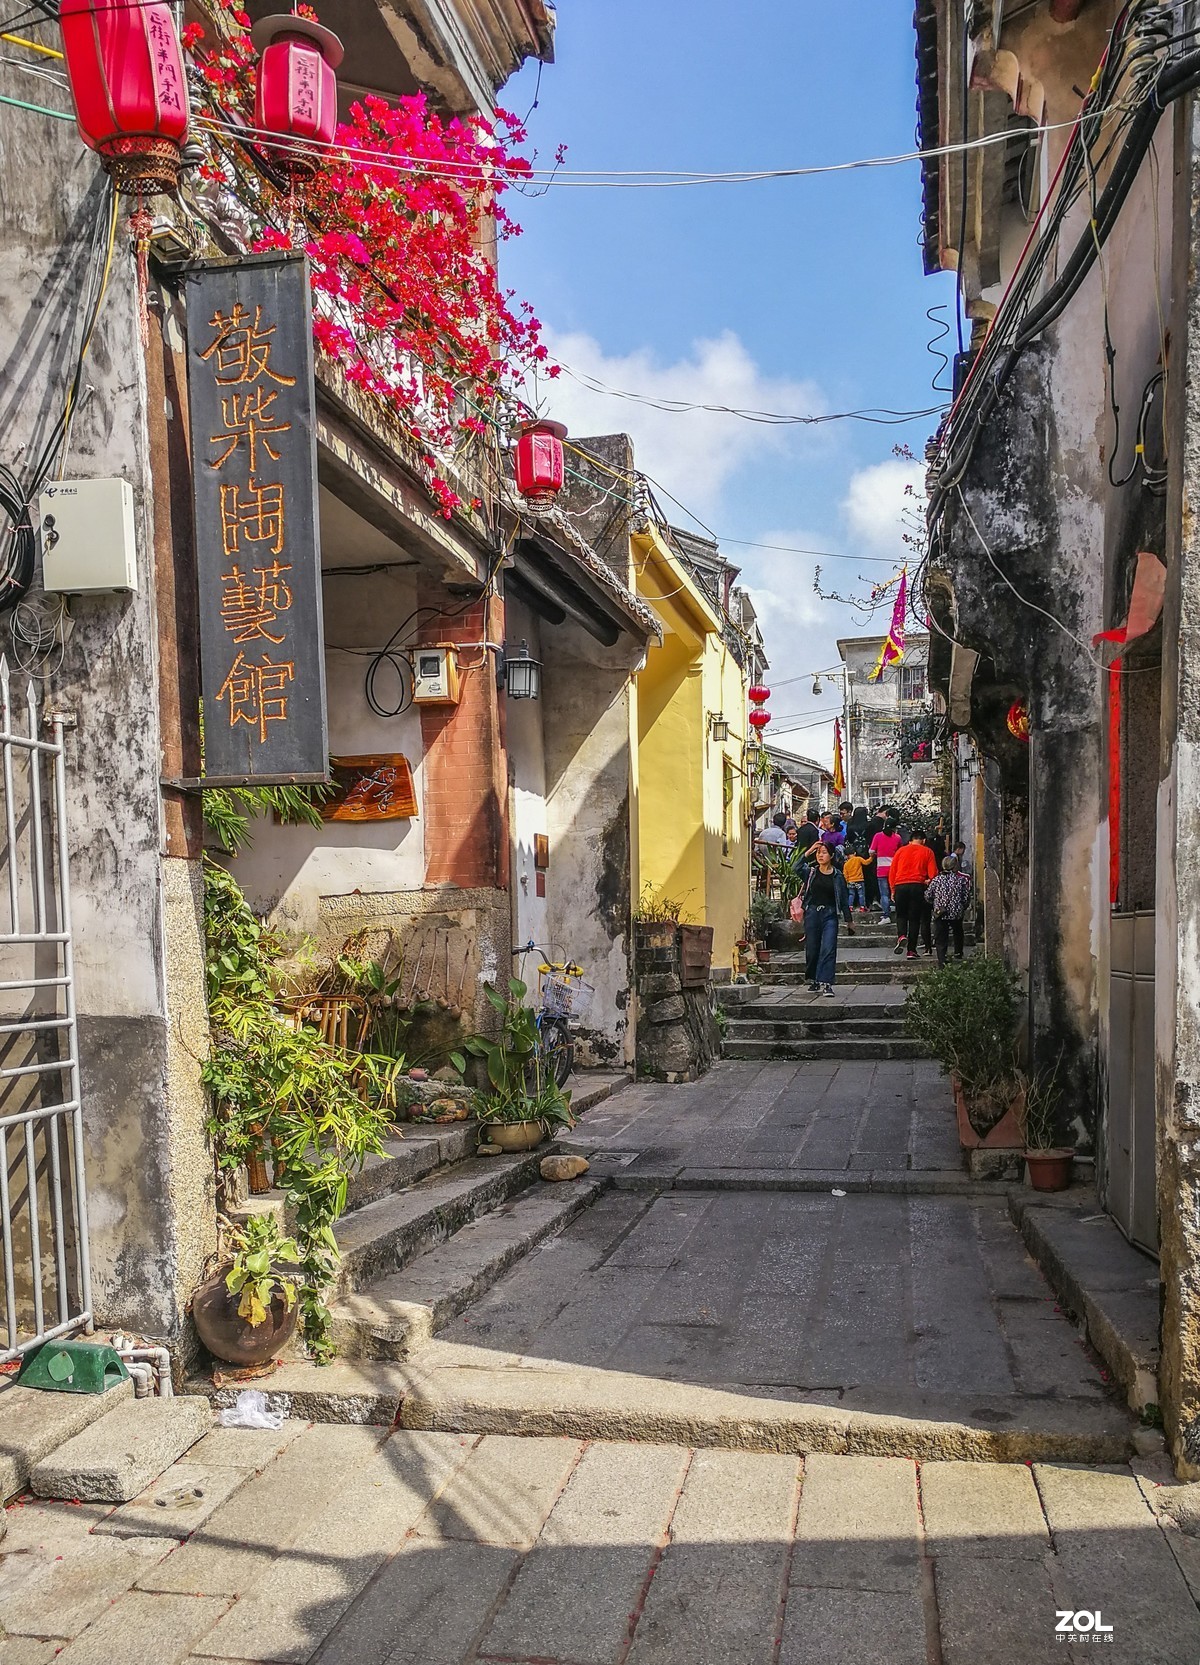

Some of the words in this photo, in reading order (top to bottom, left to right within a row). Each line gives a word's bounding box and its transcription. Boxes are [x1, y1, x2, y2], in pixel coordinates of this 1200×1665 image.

[201, 302, 297, 744] 敬柴陶藝館
